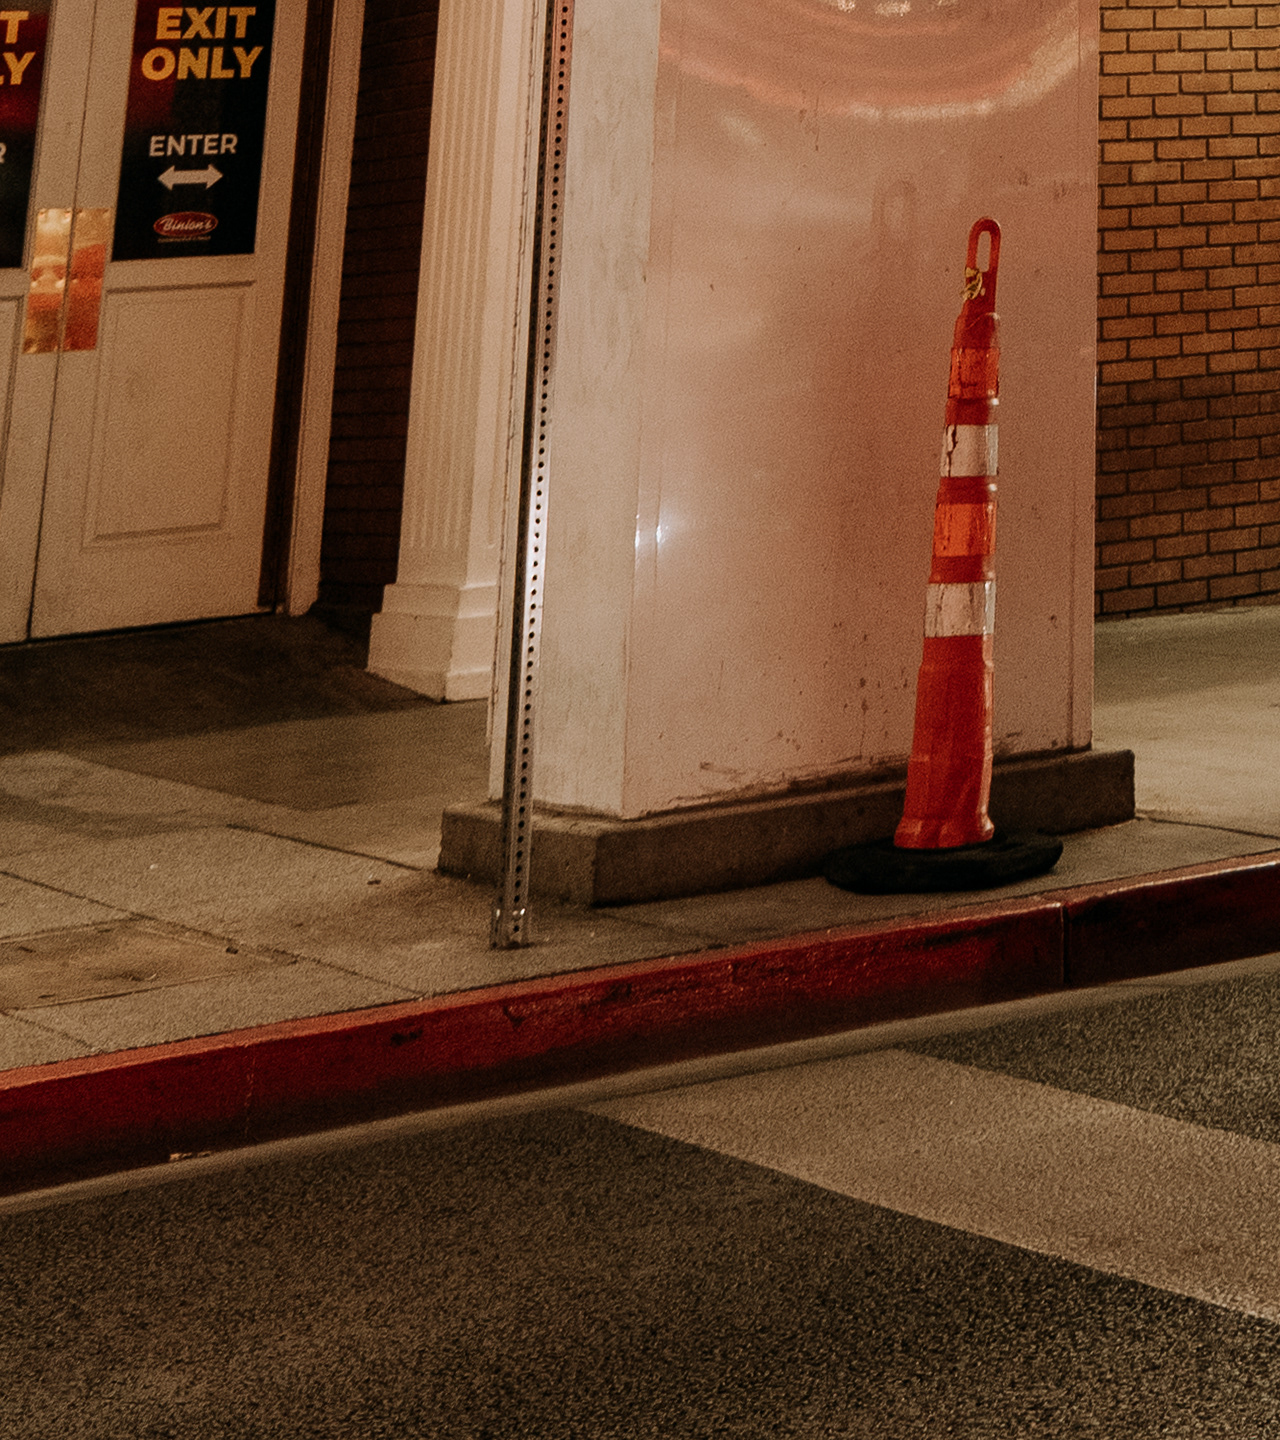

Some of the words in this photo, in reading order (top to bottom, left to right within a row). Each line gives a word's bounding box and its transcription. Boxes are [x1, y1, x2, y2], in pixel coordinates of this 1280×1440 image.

[156, 6, 257, 40] EXIT
[141, 46, 264, 81] ONLY
[149, 133, 239, 157] ENTER
